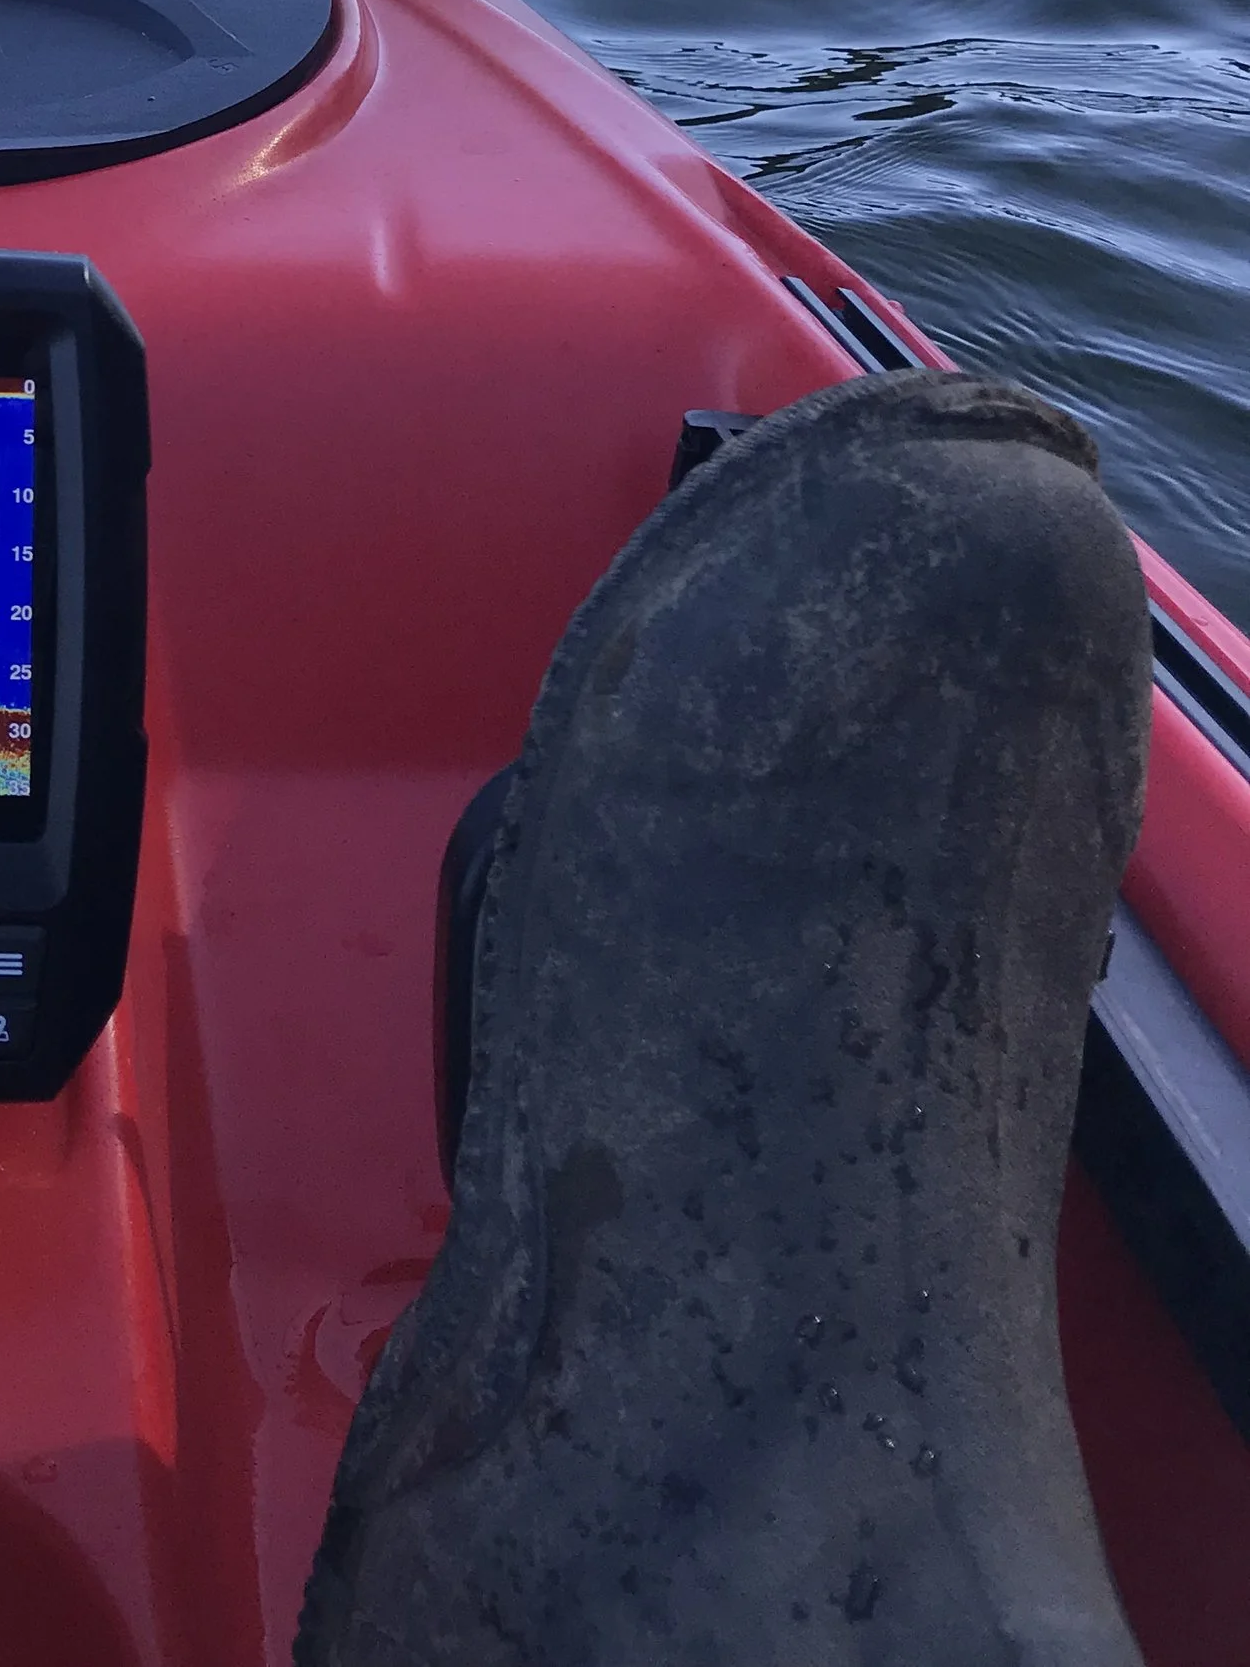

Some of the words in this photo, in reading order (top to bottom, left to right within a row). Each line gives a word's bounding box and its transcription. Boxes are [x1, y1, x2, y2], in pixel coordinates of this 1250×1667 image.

[23, 379, 35, 395] 0
[23, 429, 35, 444] 5
[12, 487, 34, 503] 10
[11, 546, 33, 562] 15
[10, 605, 33, 621] 20
[9, 664, 32, 680] 25
[8, 723, 31, 738] 30
[7, 781, 31, 795] 35
